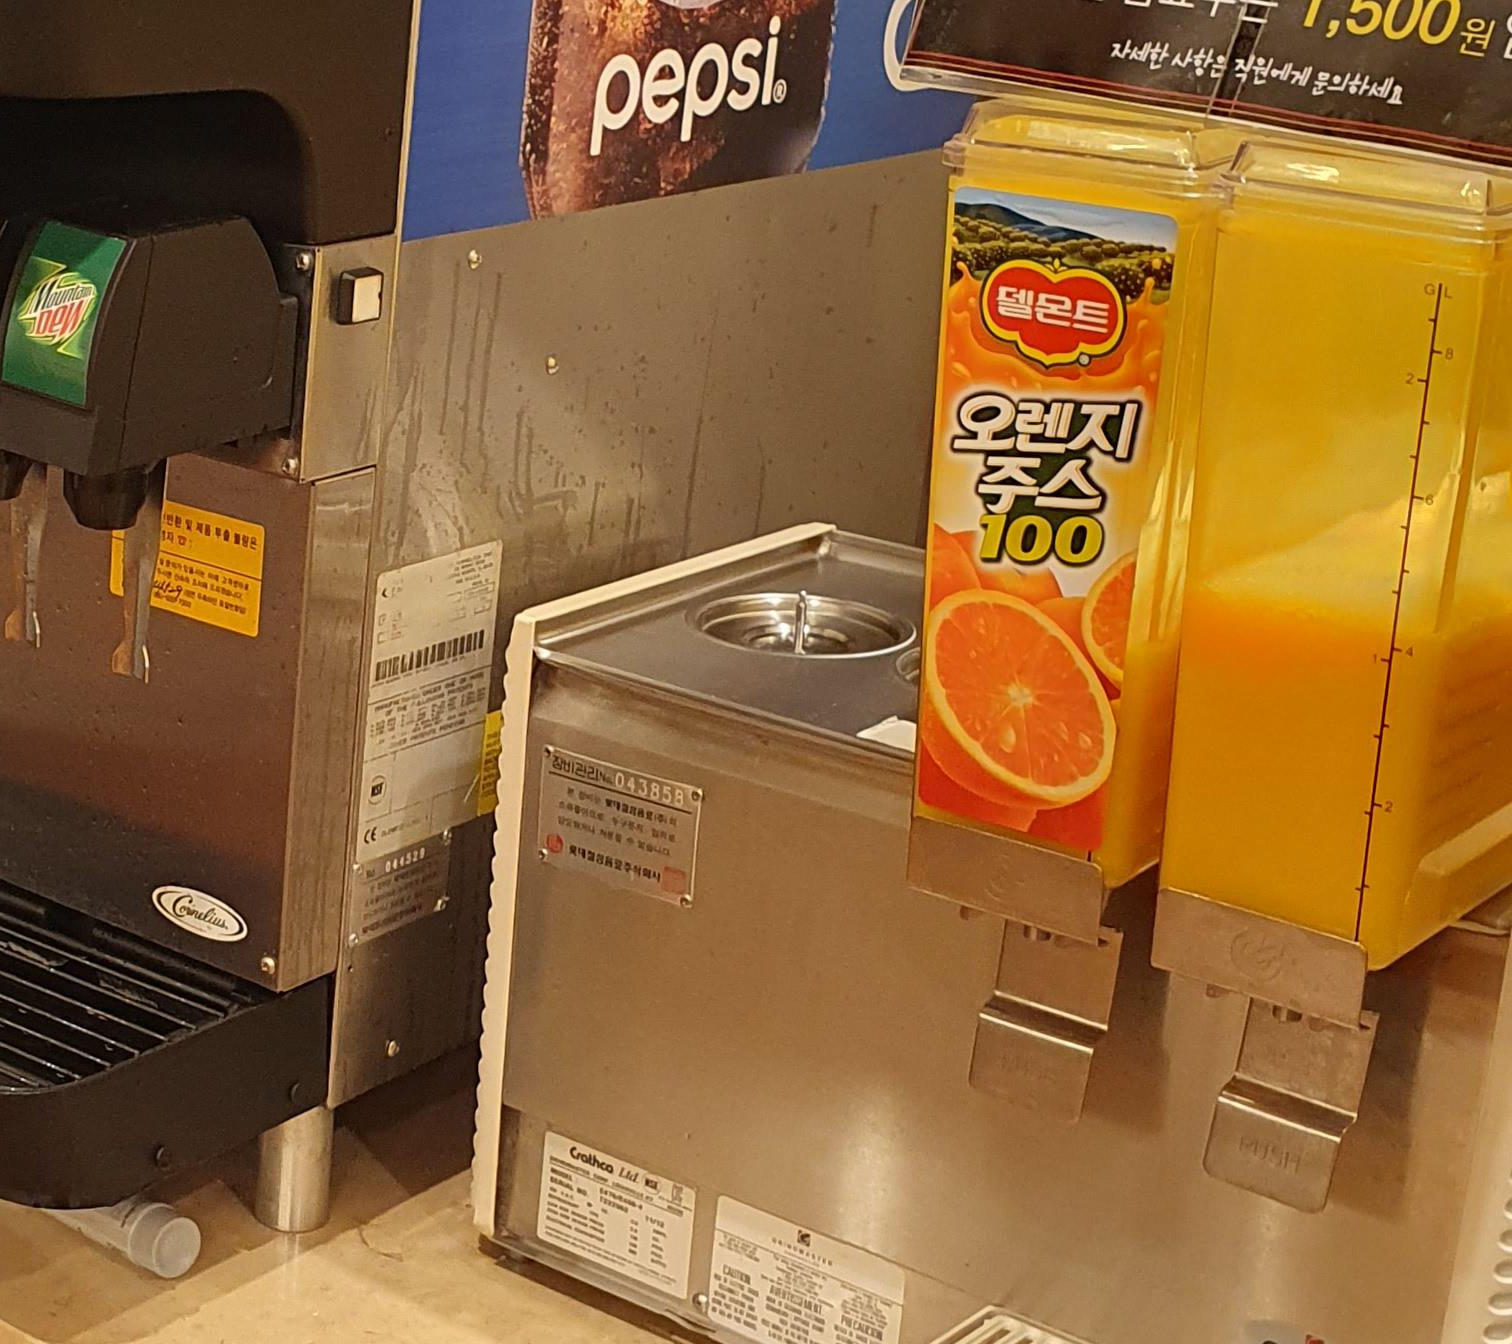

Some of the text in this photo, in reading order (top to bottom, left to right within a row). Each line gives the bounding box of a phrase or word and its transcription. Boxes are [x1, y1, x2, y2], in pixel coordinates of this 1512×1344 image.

[590, 16, 782, 156] pepsi
[1110, 39, 1404, 104] 자세한 사항은 직원에게 문의하세요
[995, 285, 1110, 334] 델몬트
[1405, 373, 1414, 385] 2
[951, 392, 1140, 462] 오렌지
[975, 456, 1106, 513] 주스
[979, 513, 1105, 564] 100
[172, 894, 228, 930] Cornelius
[569, 1146, 614, 1174] Crathco
